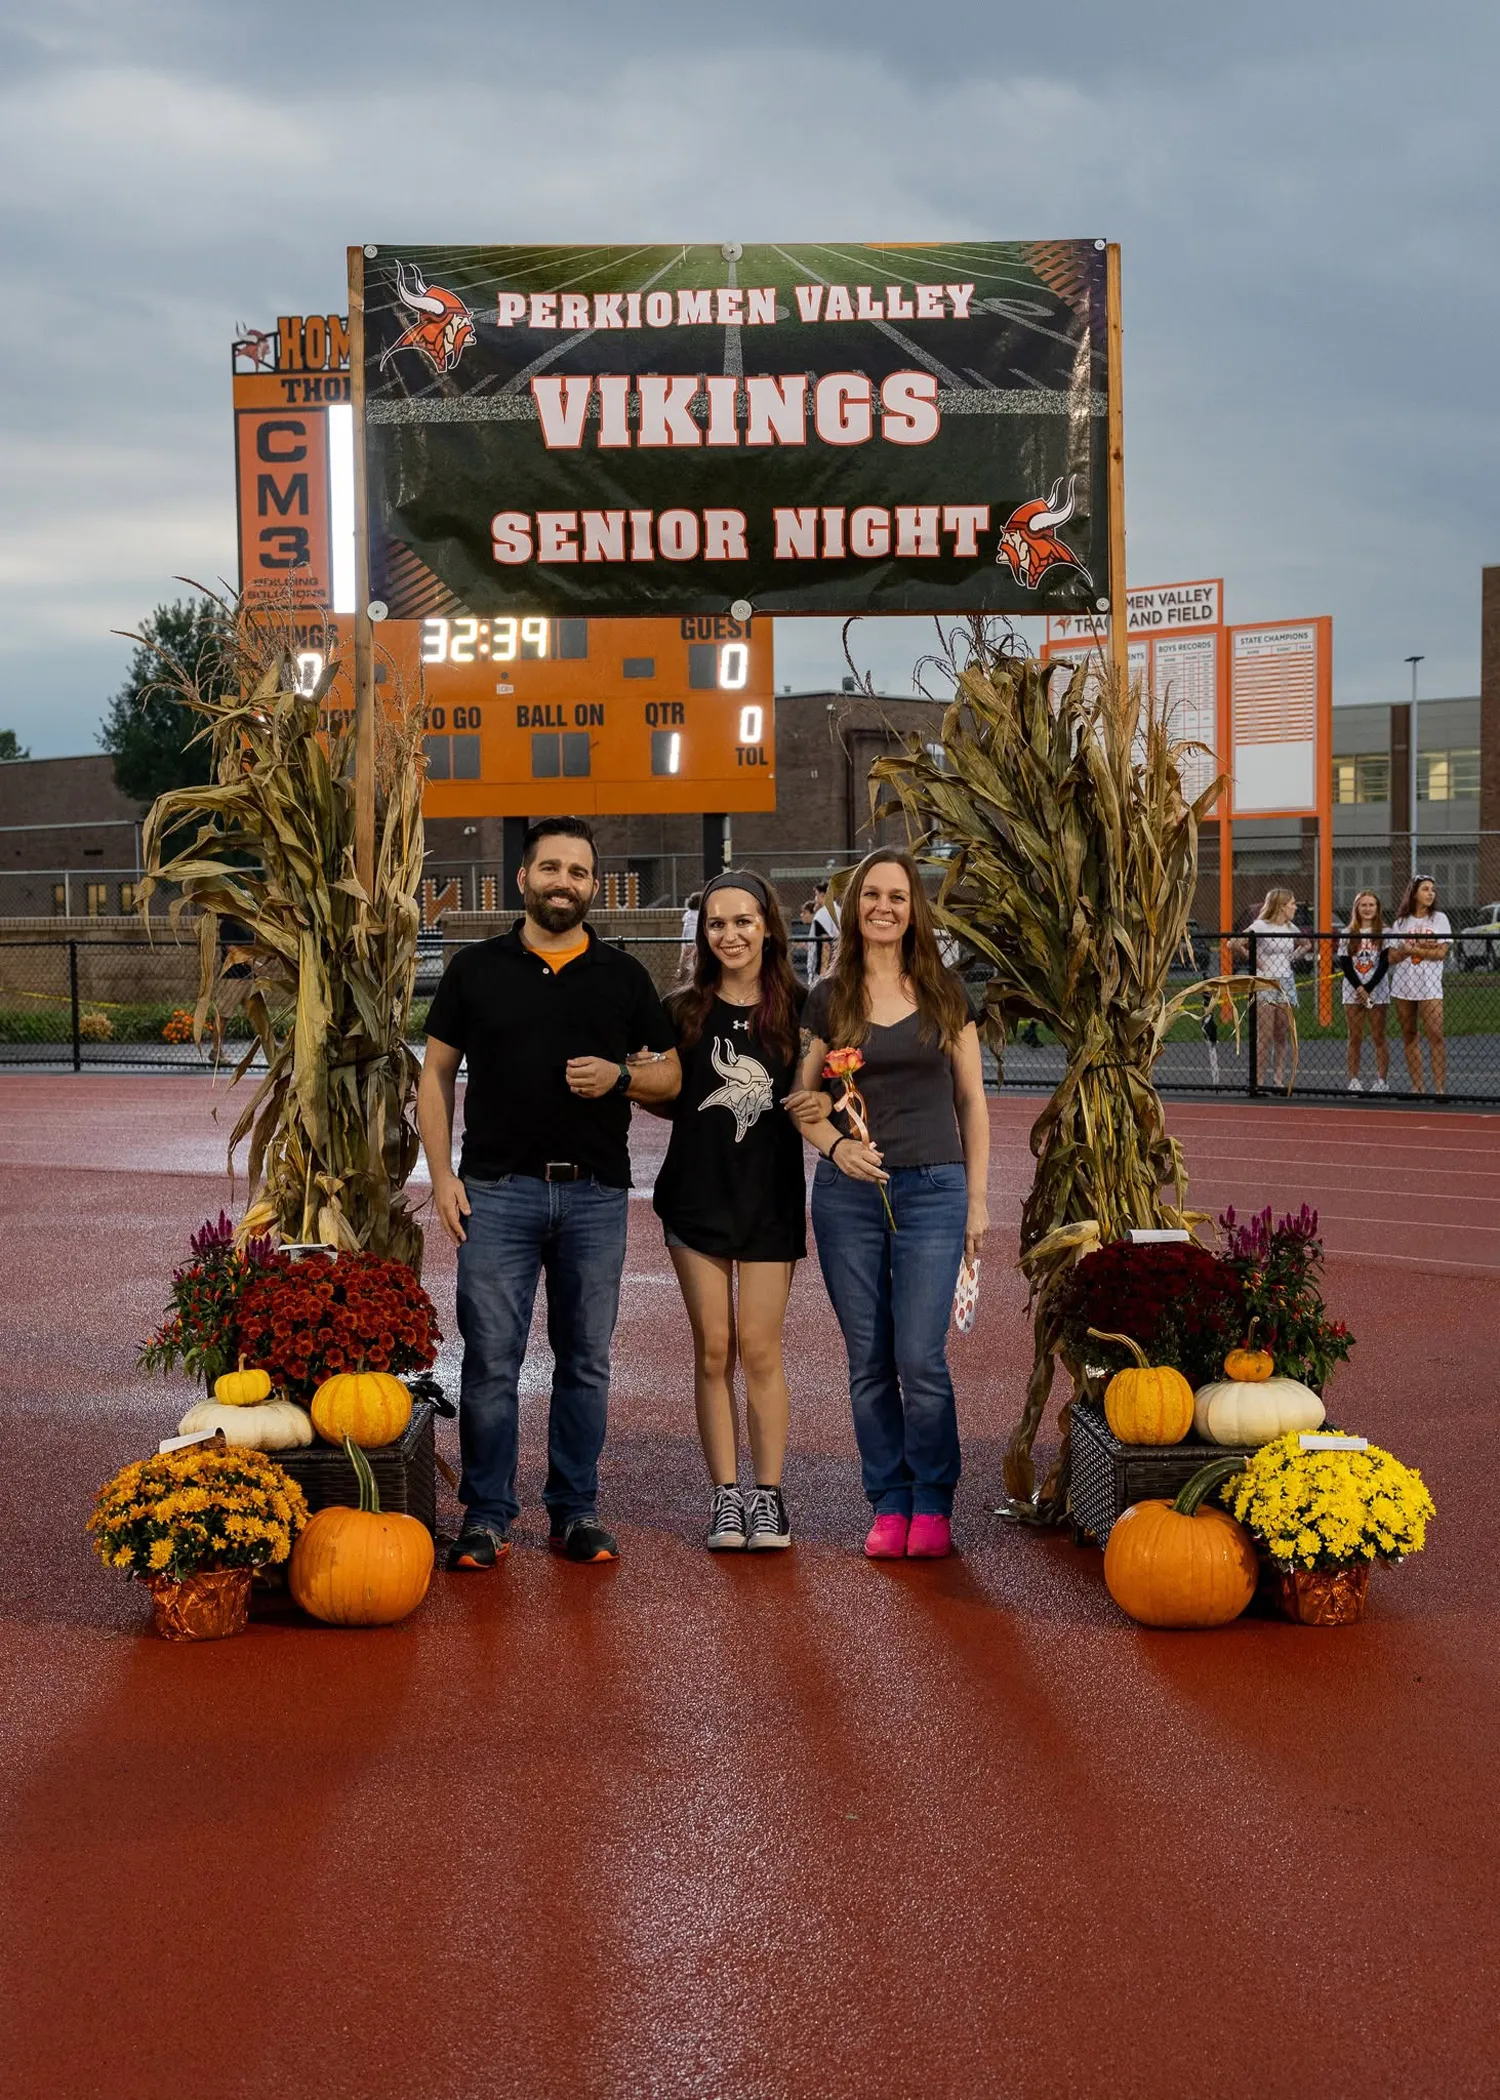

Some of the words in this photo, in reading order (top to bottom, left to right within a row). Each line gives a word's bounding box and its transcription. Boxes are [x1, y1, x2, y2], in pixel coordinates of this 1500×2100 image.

[496, 288, 776, 329] PERKIOMEN
[794, 282, 976, 323] VALLEY
[277, 315, 350, 372] HOM
[281, 377, 350, 403] THO
[531, 370, 941, 449] VIKINGS
[491, 509, 749, 565] SENIOR
[772, 505, 991, 562] NIGHT
[247, 589, 326, 599] SOLUIONS
[1158, 588, 1213, 606] VALLEY
[680, 616, 753, 640] GUEST
[1074, 616, 1108, 633] TRA
[1129, 610, 1163, 628] AND
[1167, 605, 1213, 624] FIELD
[422, 617, 548, 662] 32:39
[1158, 644, 1177, 653] BOYS
[1178, 640, 1212, 651] RECORDS
[1240, 636, 1262, 645] STATE
[1263, 632, 1309, 643] CHAMPIONS
[719, 643, 748, 689] 0
[453, 706, 482, 729] GO
[516, 705, 568, 728] BALL
[574, 704, 605, 726] ON
[645, 702, 686, 728] QTR
[735, 747, 769, 766] TOL
